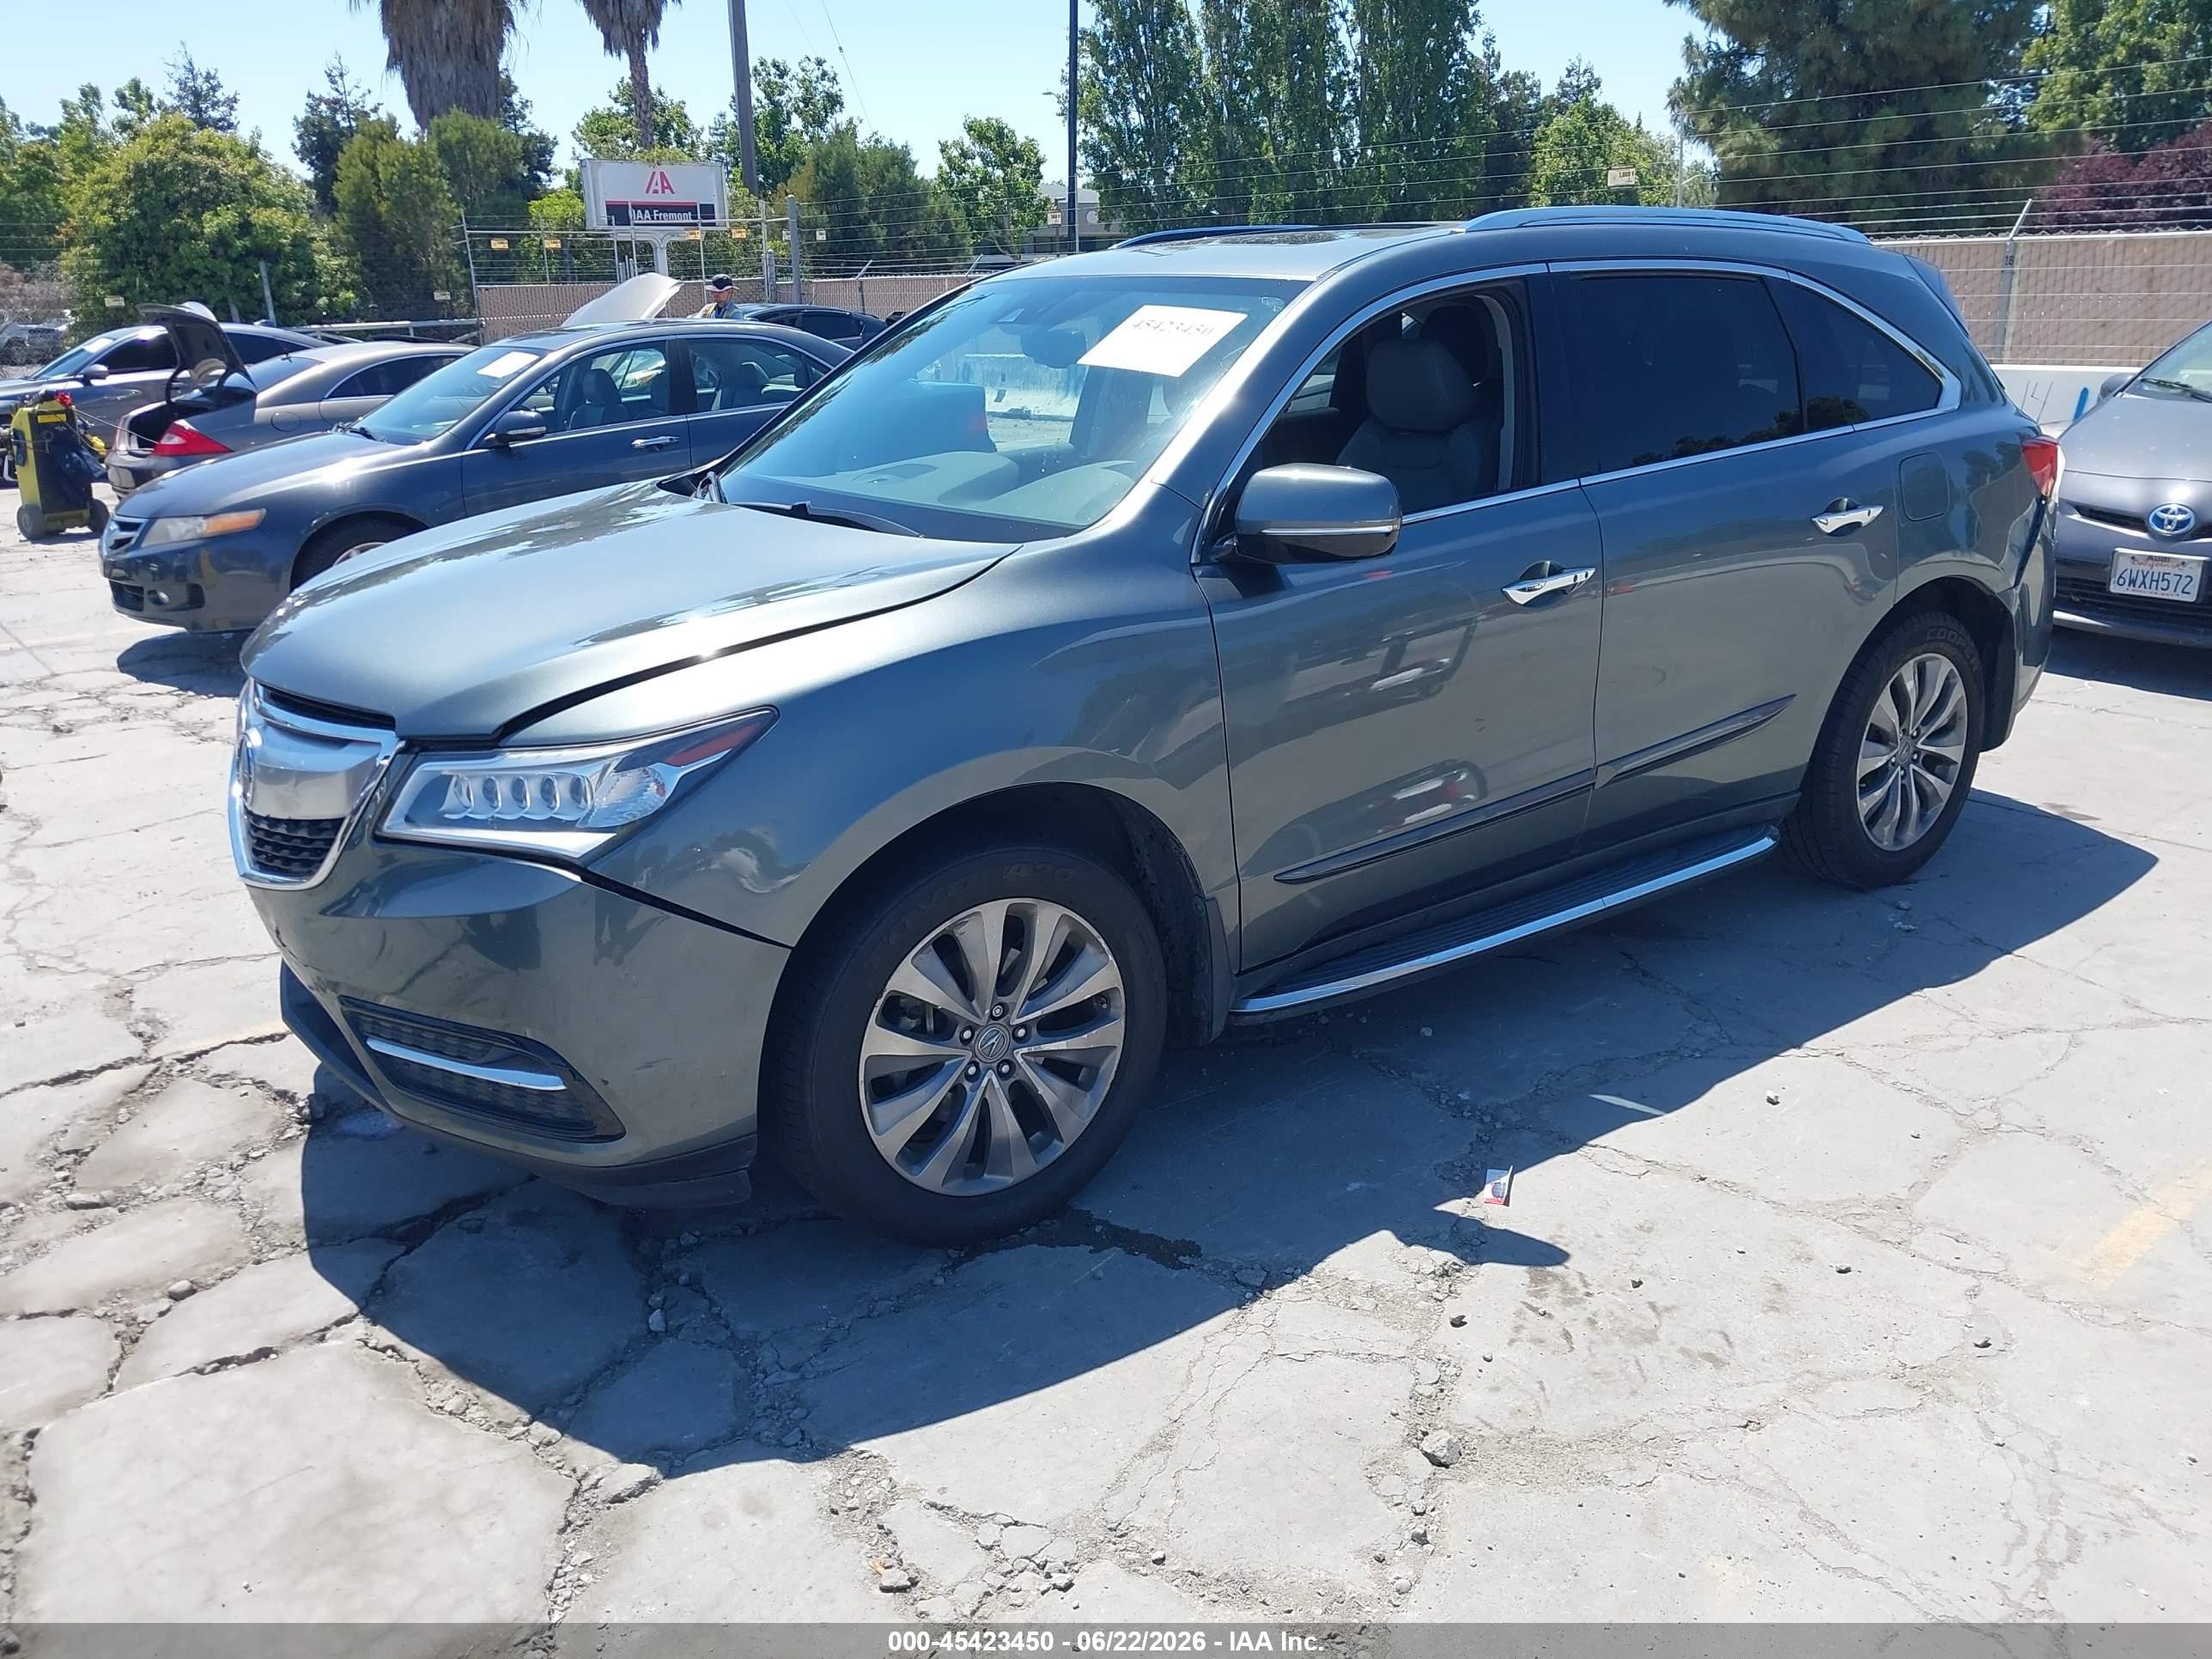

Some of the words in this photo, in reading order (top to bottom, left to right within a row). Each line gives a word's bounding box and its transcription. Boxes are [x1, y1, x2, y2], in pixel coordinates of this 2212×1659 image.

[632, 210, 652, 221] IAA
[653, 210, 692, 221] Fremont
[2117, 568, 2194, 595] 6WXH572
